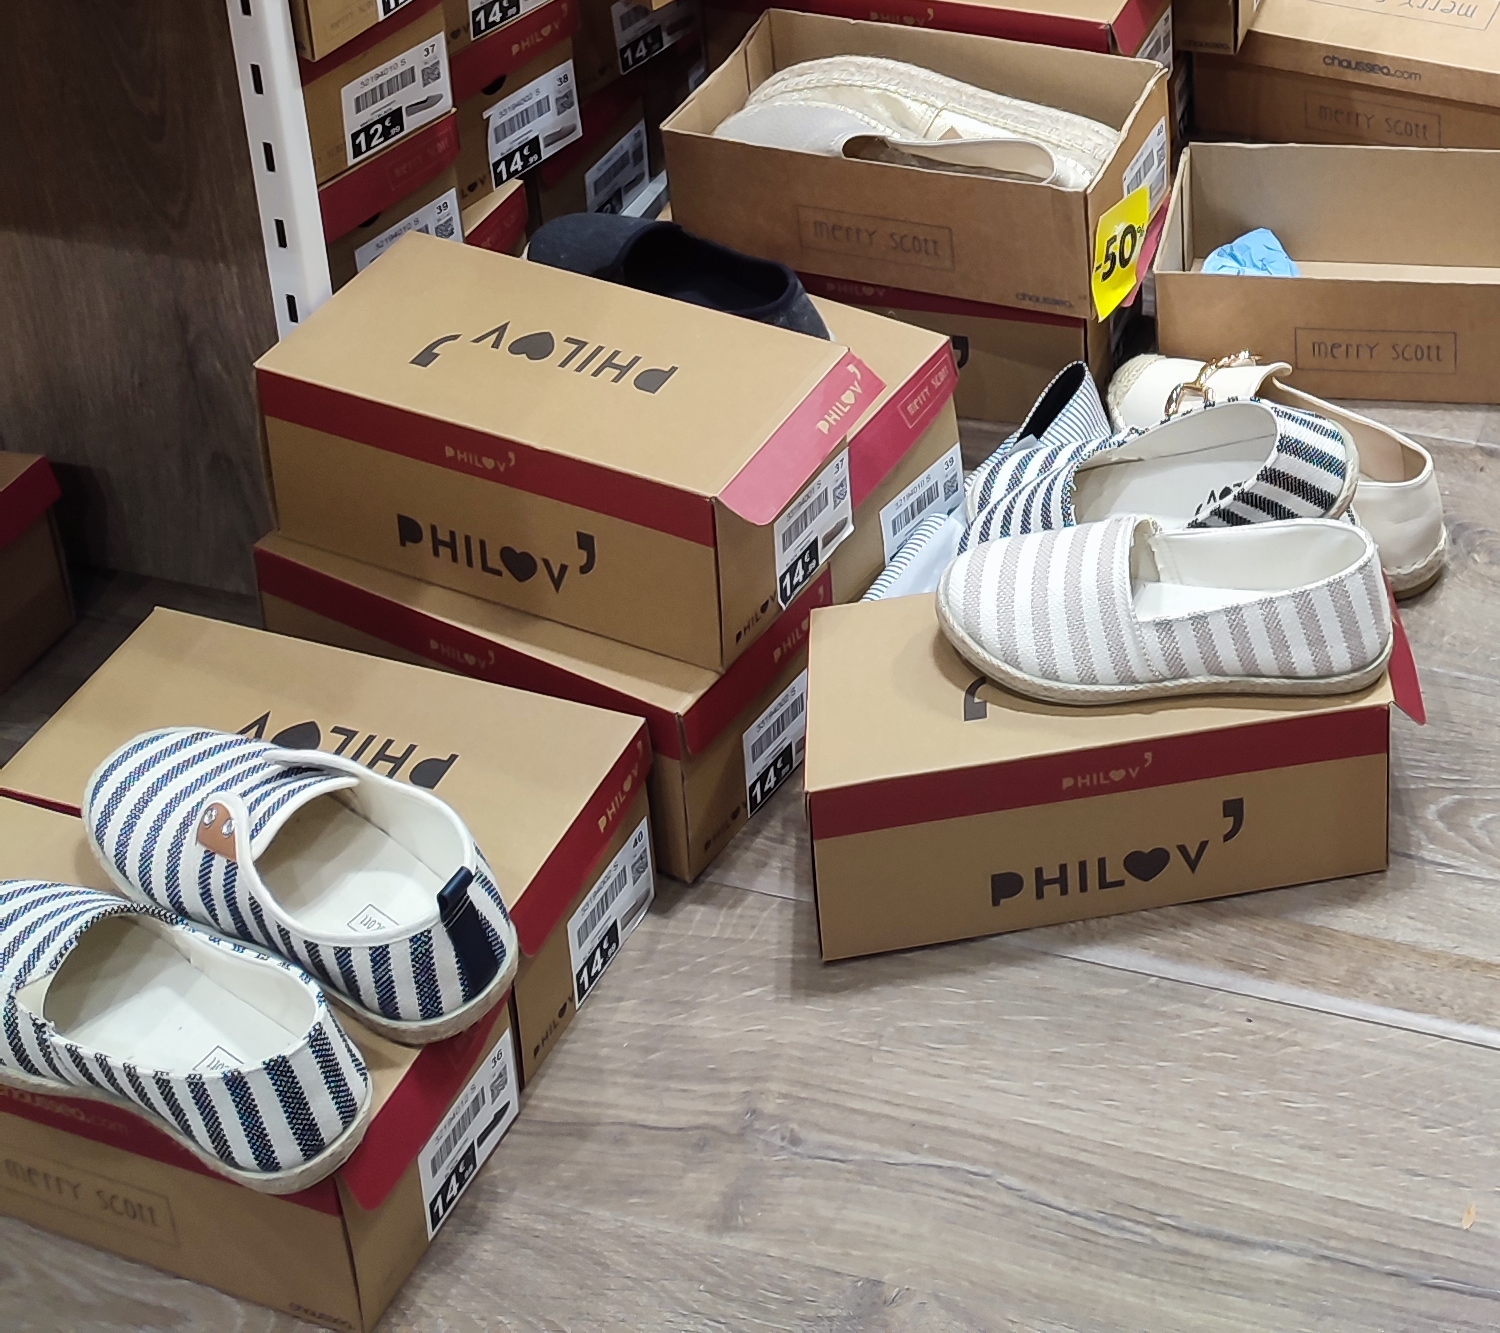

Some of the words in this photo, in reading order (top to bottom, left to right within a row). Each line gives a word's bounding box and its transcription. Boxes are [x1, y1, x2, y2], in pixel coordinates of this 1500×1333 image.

[424, 43, 436, 57] 37
[557, 74, 569, 86] 38
[1318, 104, 1376, 132] merry
[1385, 117, 1430, 140] scott
[1095, 226, 1144, 283] -50%
[1311, 339, 1376, 361] merry
[1390, 340, 1442, 362] scott
[834, 458, 845, 475] 37
[944, 457, 954, 470] 39
